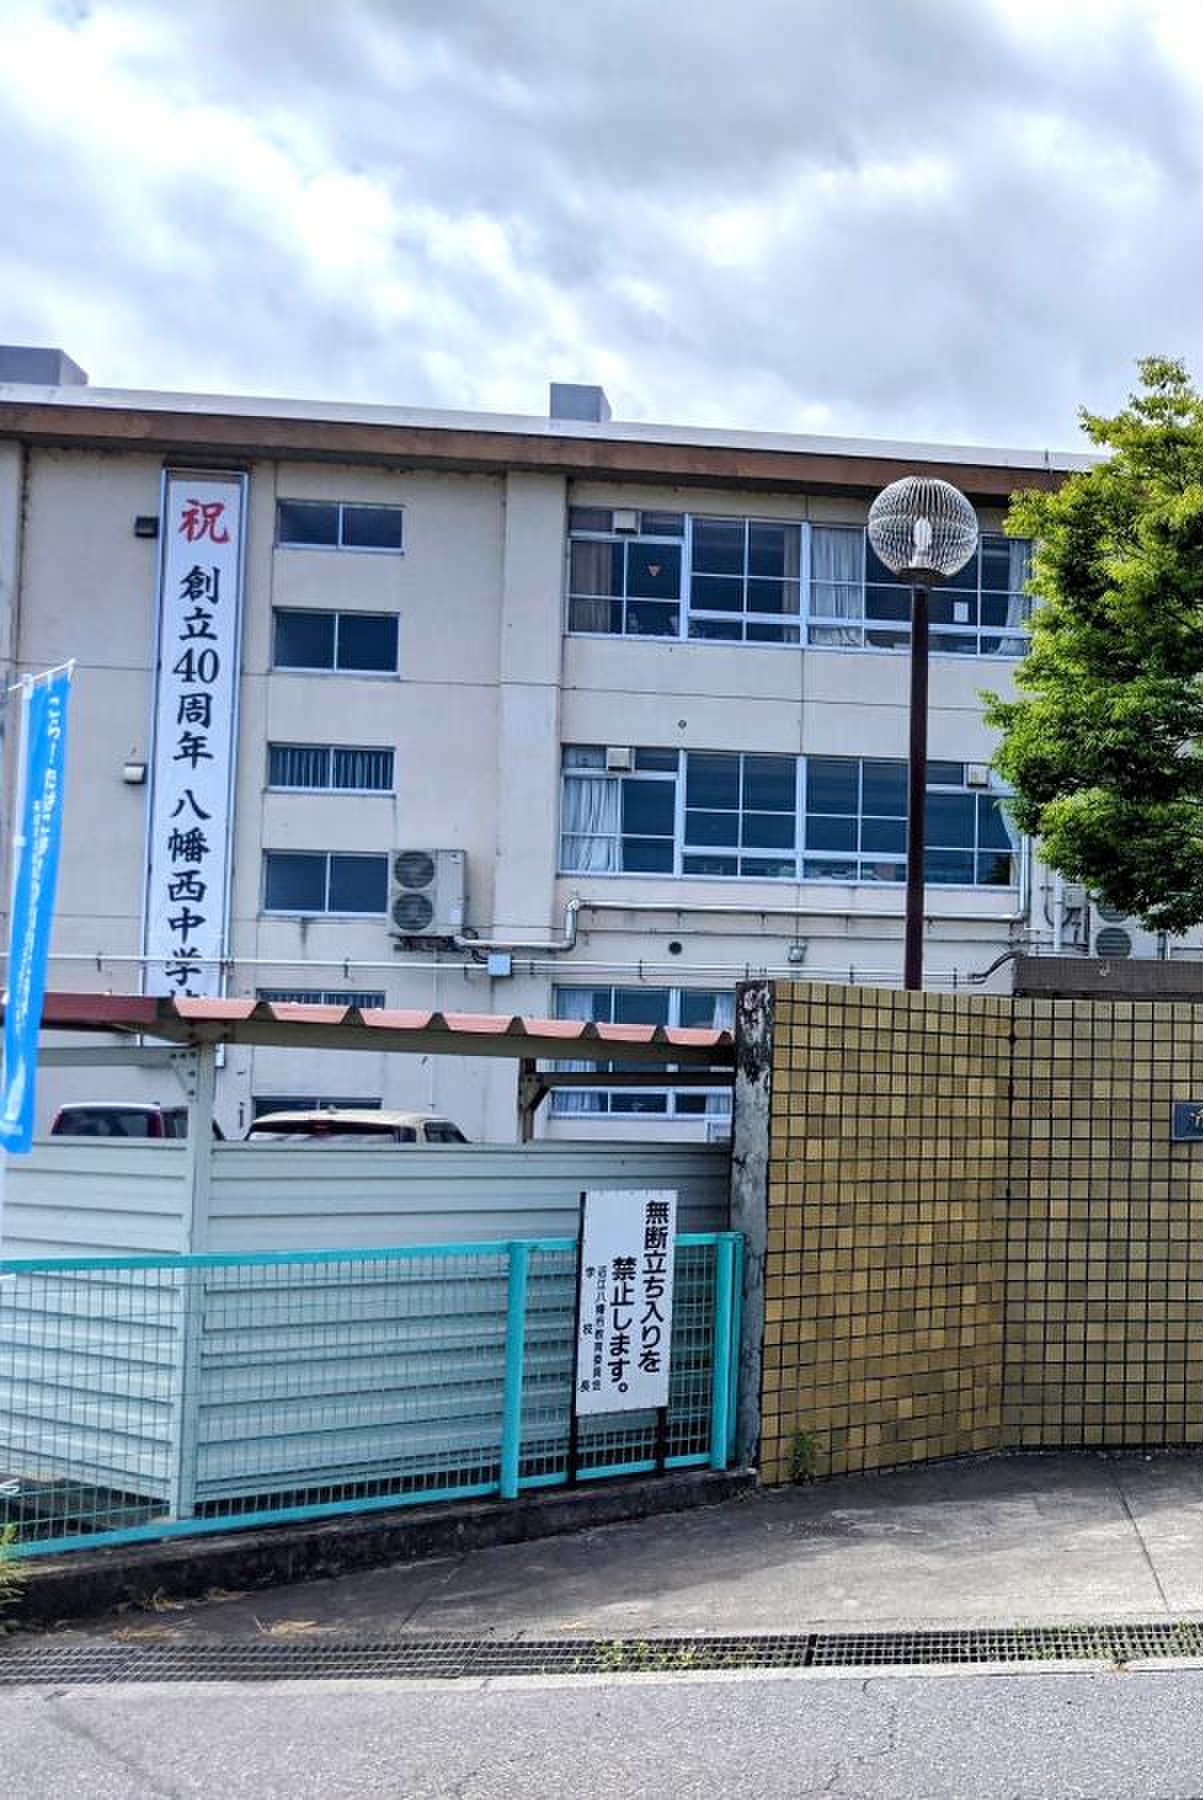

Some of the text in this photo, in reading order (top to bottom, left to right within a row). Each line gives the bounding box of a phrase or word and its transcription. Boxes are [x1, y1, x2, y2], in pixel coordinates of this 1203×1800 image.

[165, 499, 229, 998] 祝 創立40周年 八幡西中学
[607, 1256, 637, 1393] 禁止します。
[638, 1200, 670, 1373] 無断立ち入りを
